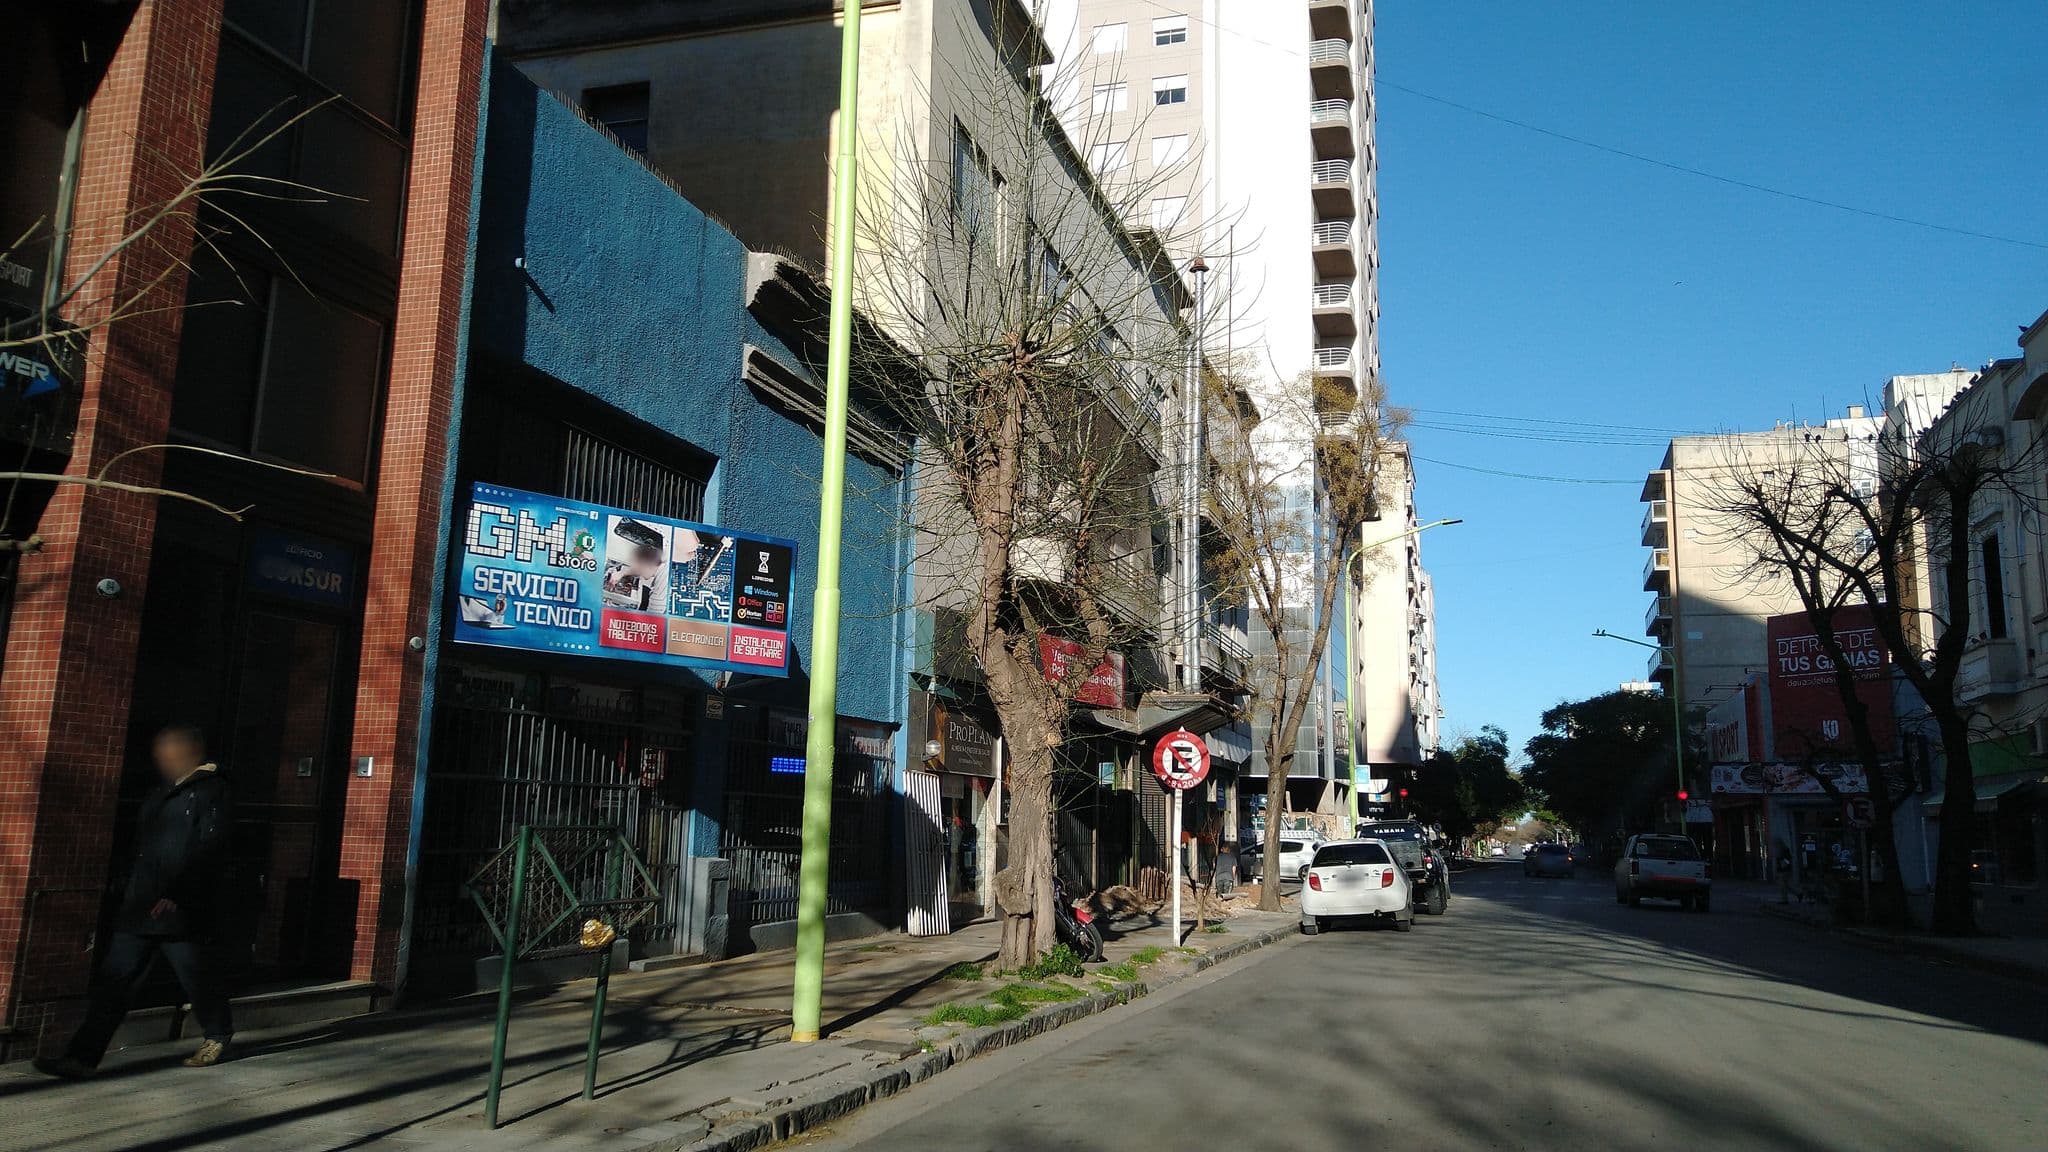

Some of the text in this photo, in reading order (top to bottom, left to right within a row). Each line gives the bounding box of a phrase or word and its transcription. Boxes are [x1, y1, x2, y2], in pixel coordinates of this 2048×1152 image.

[465, 502, 597, 572] GM store
[473, 566, 579, 603] SERVICIO
[753, 587, 779, 598] Windows
[513, 600, 593, 630] TECNICO
[609, 618, 657, 634] NOTEBOOKS
[607, 628, 658, 645] TABLET Y PC
[671, 631, 725, 647] ELECTRONICA
[734, 635, 784, 650] INSTALACION
[1778, 631, 1874, 656] DETRS DE
[733, 645, 783, 660] DE SOFTWARE
[1779, 655, 1811, 672] TUS
